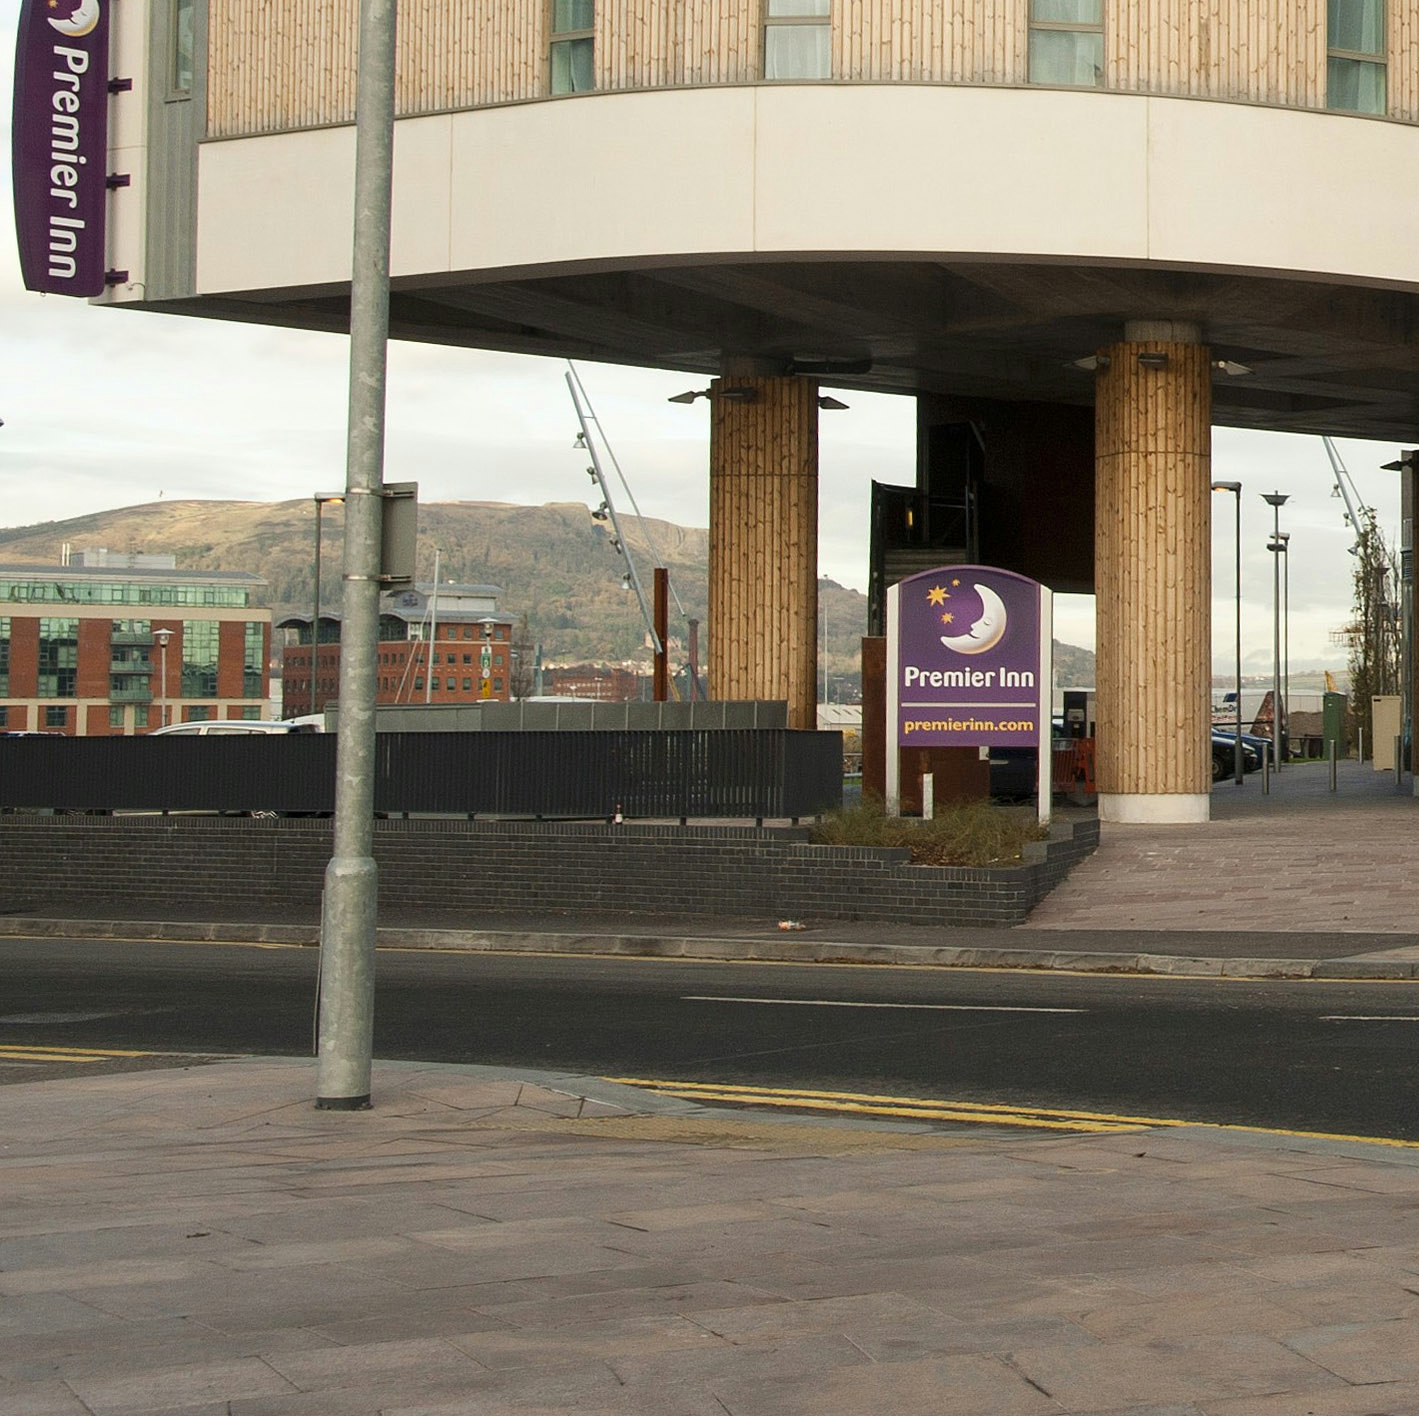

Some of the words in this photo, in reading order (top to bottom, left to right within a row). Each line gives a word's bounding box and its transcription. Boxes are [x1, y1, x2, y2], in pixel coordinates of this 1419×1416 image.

[50, 44, 90, 209] Premier
[48, 215, 86, 279] Inn
[904, 666, 996, 688] Premier
[999, 667, 1035, 688] Inn
[904, 718, 1034, 734] premierinn.com
